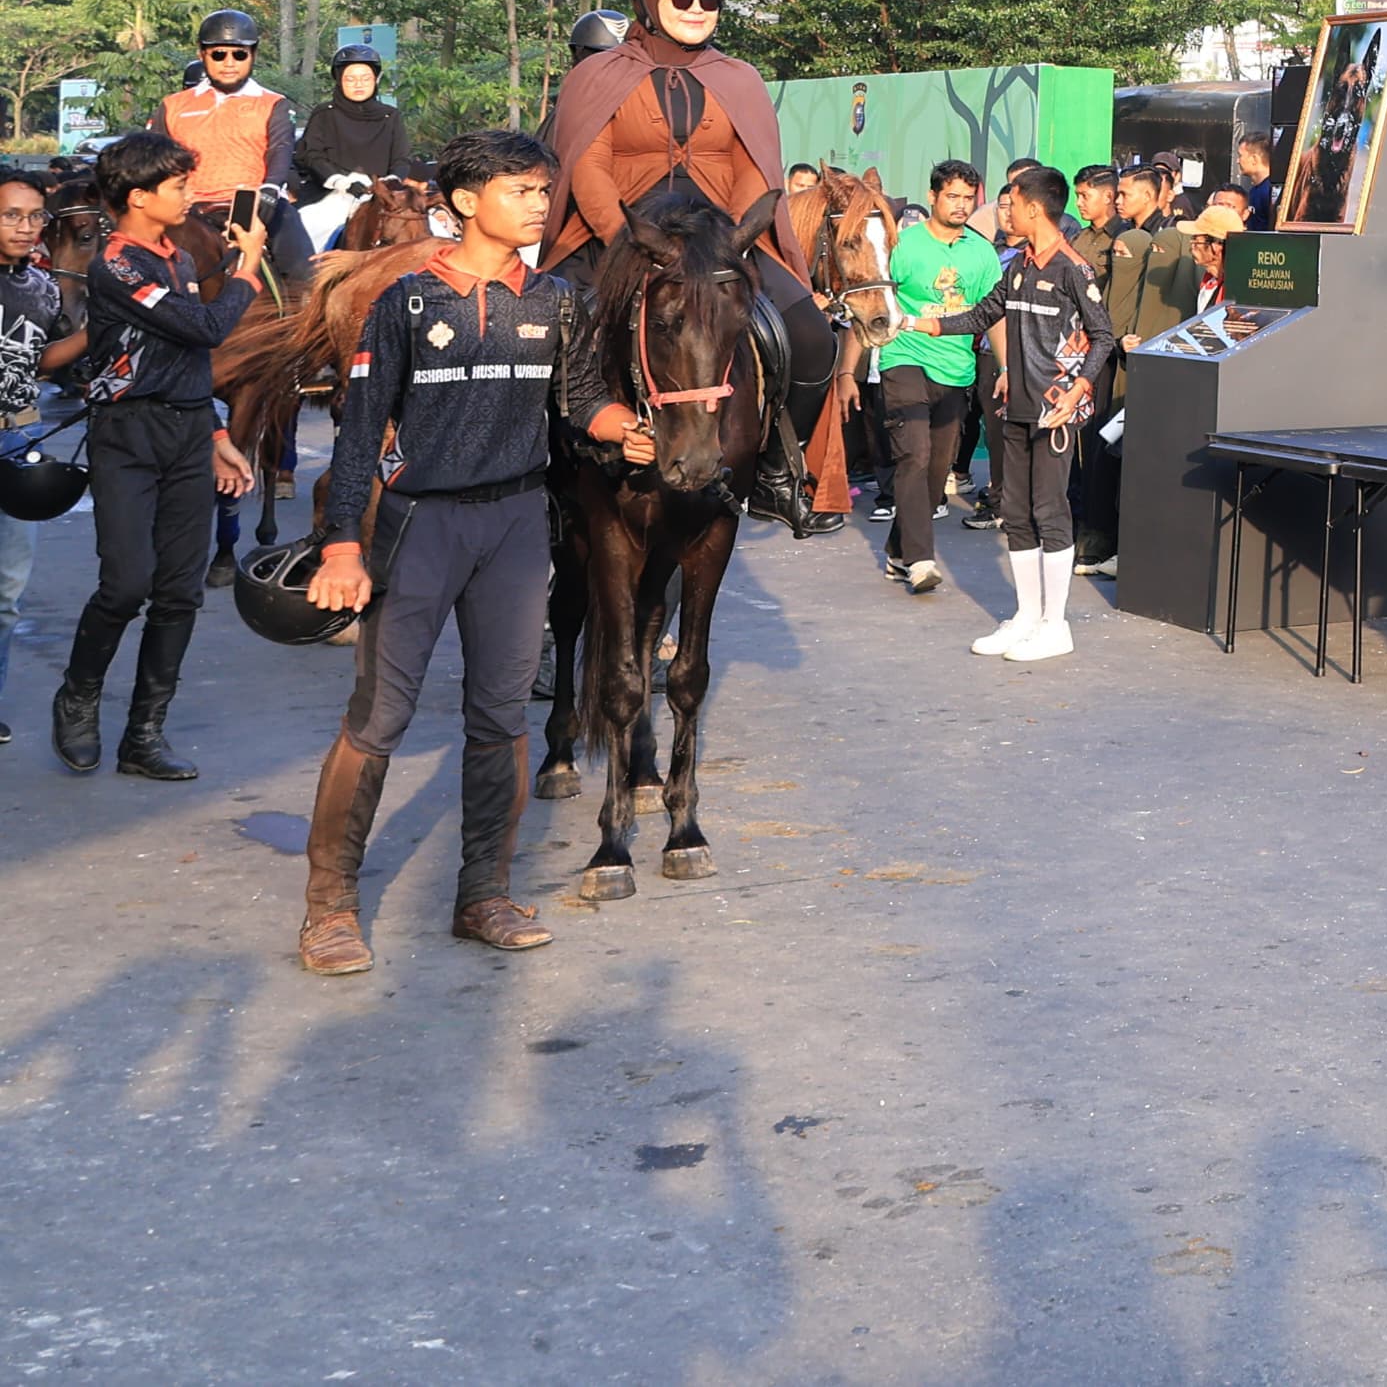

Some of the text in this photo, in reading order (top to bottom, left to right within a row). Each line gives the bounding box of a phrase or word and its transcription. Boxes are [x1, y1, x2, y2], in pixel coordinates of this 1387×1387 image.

[1258, 251, 1286, 265] RENO
[1252, 268, 1291, 280] PAHLAWAN
[413, 367, 468, 384] ASHABUL
[472, 365, 511, 379] HUSNA
